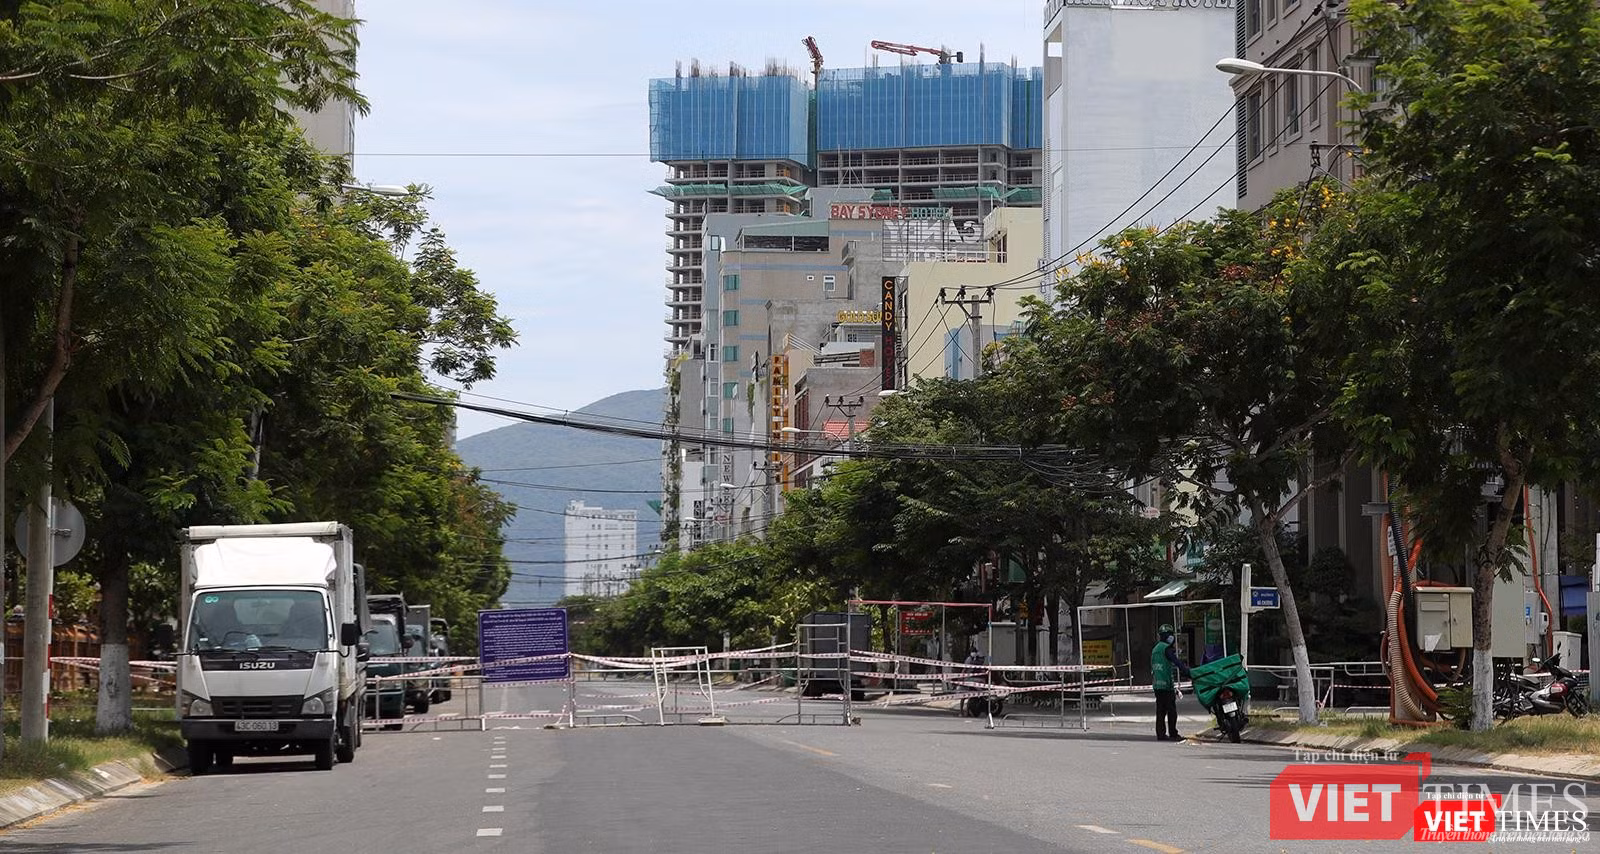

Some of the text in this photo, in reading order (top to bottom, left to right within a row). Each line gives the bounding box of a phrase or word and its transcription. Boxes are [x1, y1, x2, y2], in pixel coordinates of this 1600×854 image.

[831, 205, 854, 219] BAY
[911, 207, 952, 220] HOTEL
[884, 280, 893, 331] CANDY
[838, 310, 864, 323] GOLD
[723, 454, 732, 482] NEW
